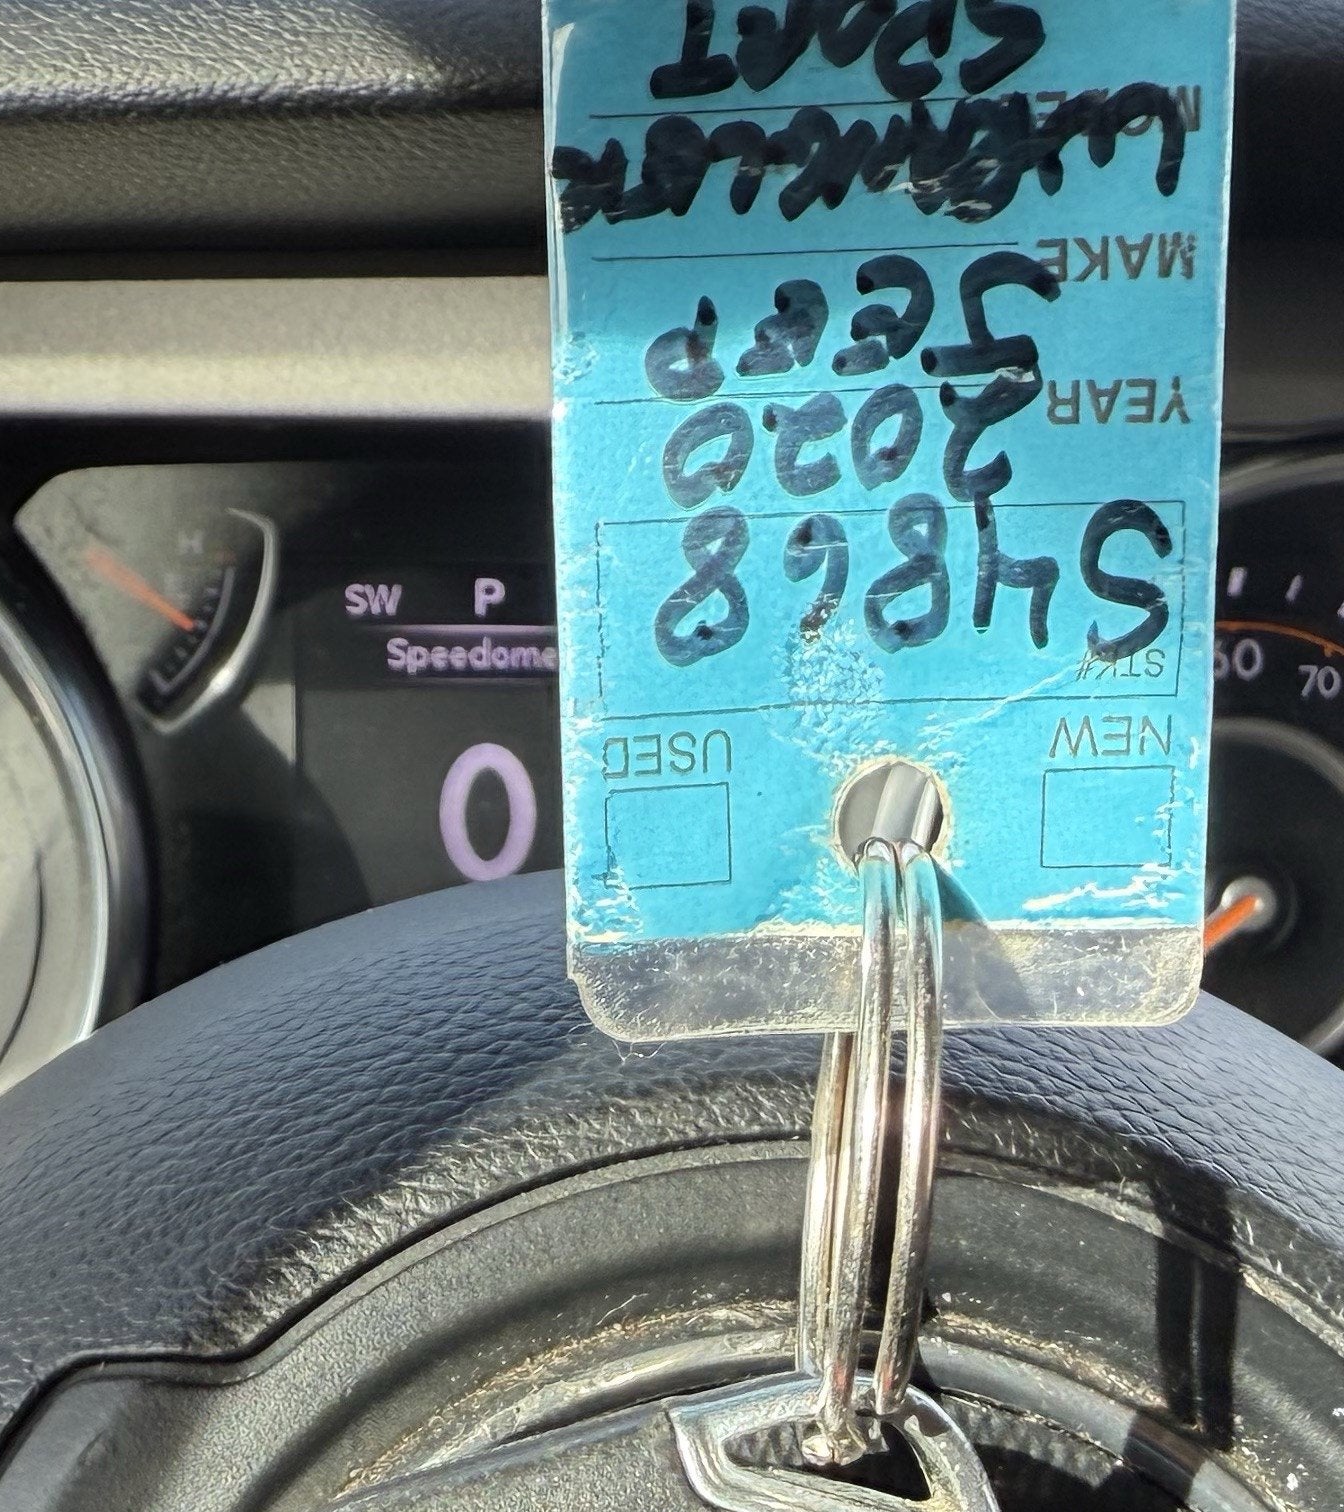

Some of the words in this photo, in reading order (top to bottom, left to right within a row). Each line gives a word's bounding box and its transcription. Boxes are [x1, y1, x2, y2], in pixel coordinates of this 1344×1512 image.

[1036, 232, 1197, 280] MAKE
[1047, 375, 1192, 425] YEAR
[662, 376, 1042, 509] 2020
[344, 583, 402, 616] SW
[475, 578, 505, 616] P
[655, 493, 1172, 667] S4868
[387, 637, 557, 674] Speedome
[1299, 665, 1342, 699] 70
[603, 729, 732, 779] USED
[1048, 716, 1172, 757] NEW
[439, 743, 536, 881] 0
